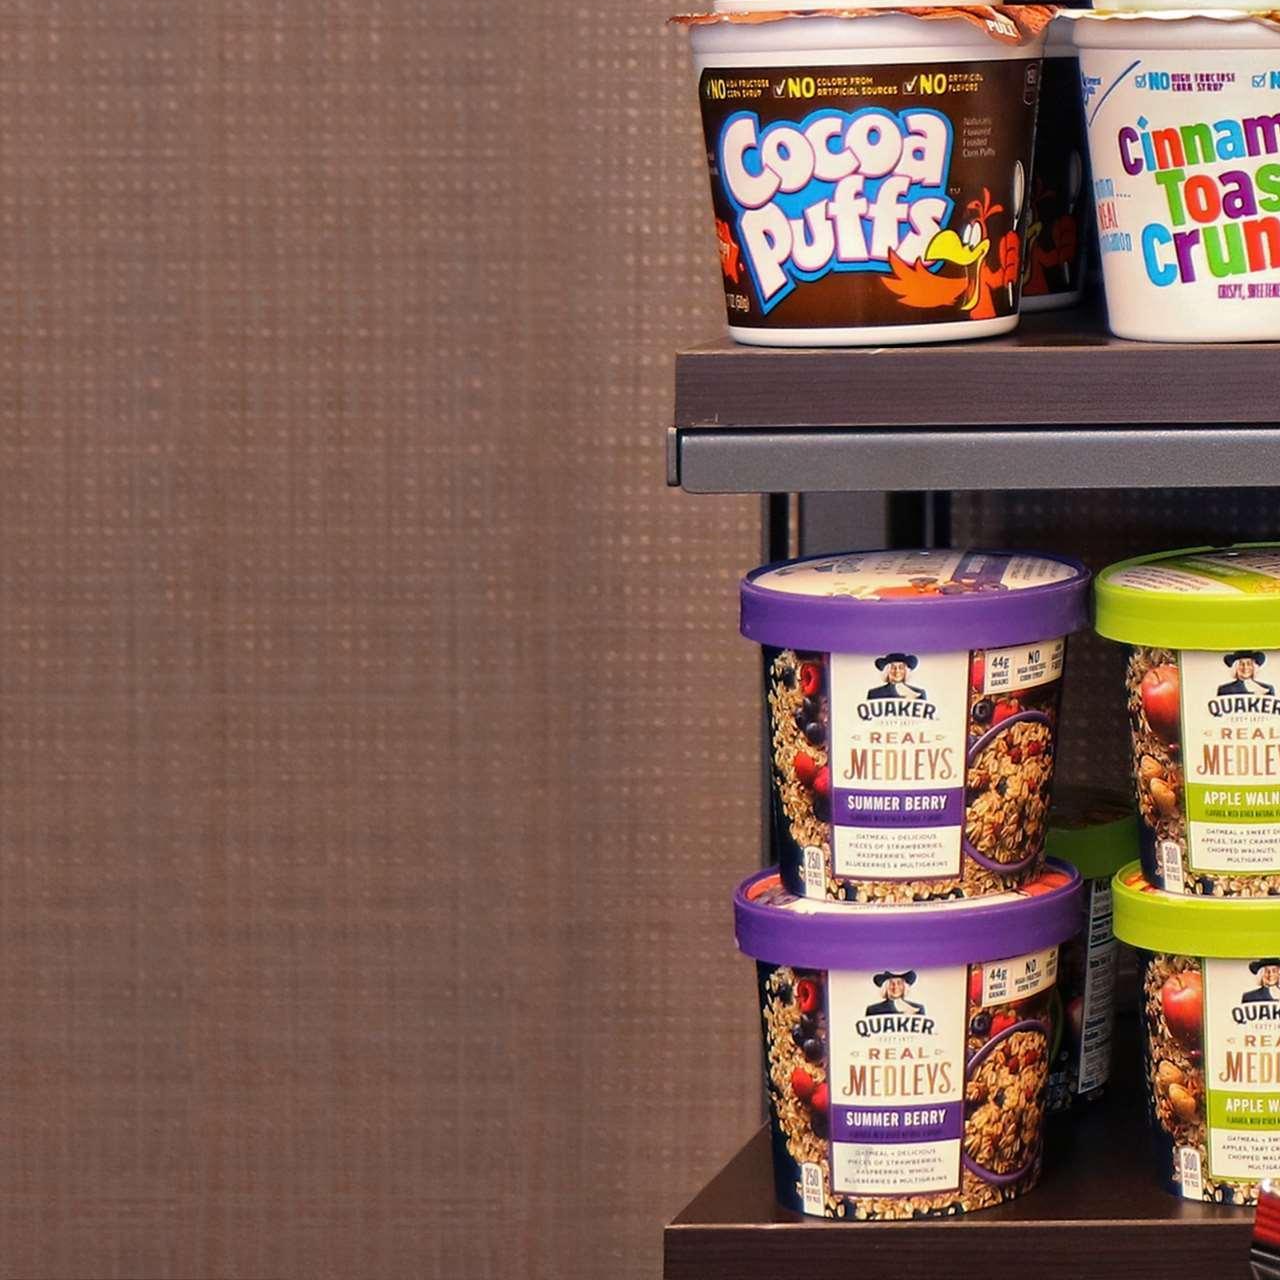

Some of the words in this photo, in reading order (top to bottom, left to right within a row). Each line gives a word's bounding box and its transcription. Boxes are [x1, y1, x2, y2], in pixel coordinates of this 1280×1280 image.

[786, 77, 816, 98] NO
[920, 74, 947, 95] NO
[1148, 72, 1170, 90] NO
[723, 113, 947, 209] Cocoa
[741, 174, 946, 300] Puffs
[991, 656, 1010, 670] 44g
[857, 701, 937, 720] QUAKER
[870, 732, 929, 744] REAL
[1221, 727, 1279, 739] REAL
[843, 747, 954, 781] MEDLEYS
[847, 796, 901, 811] SUMMER
[905, 795, 947, 810] BERRY
[1204, 791, 1241, 806] APPLE
[856, 1018, 935, 1037] QUAKER
[869, 1048, 928, 1059] REAL
[842, 1062, 952, 1097] MEDLEYS
[1226, 1099, 1263, 1112] APPLE
[846, 1111, 899, 1126] SUMMER
[904, 1110, 946, 1125] BERRY
